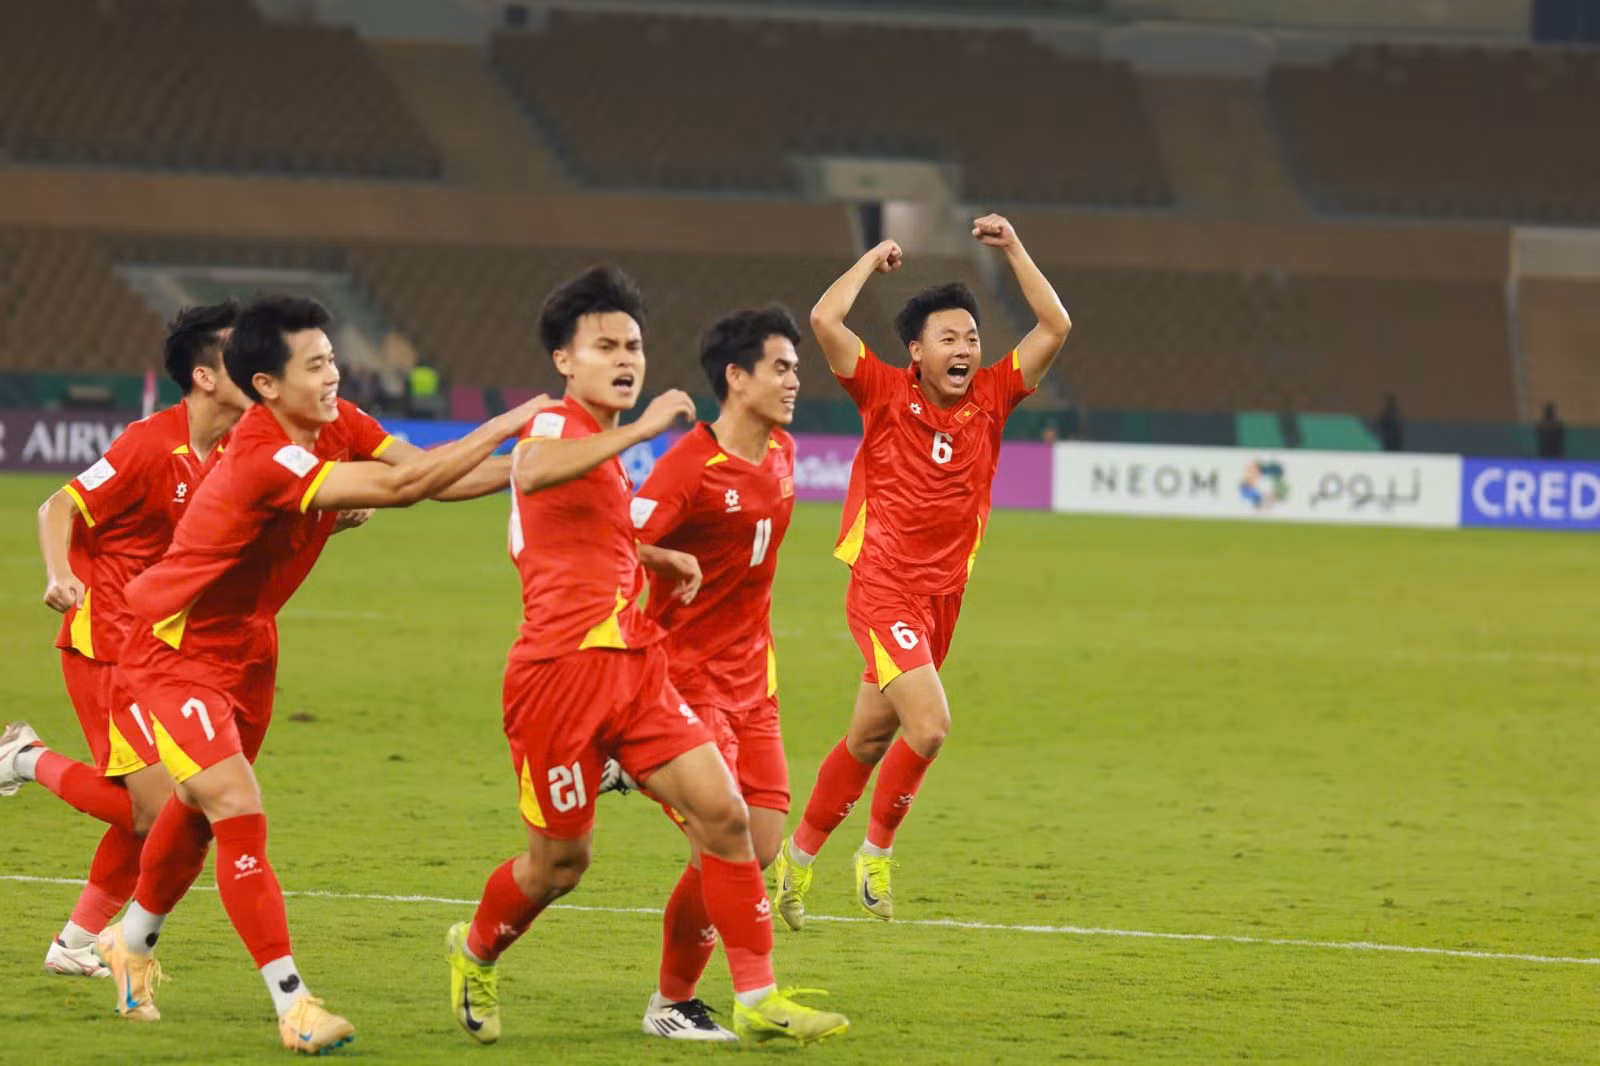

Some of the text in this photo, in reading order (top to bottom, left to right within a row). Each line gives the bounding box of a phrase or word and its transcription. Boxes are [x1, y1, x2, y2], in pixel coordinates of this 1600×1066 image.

[931, 431, 953, 464] 6
[1091, 464, 1220, 497] NEOM
[1472, 466, 1600, 520] CRED
[750, 518, 772, 568] 11
[890, 621, 919, 650] 6
[181, 697, 216, 741] 7
[547, 760, 587, 813] 21
